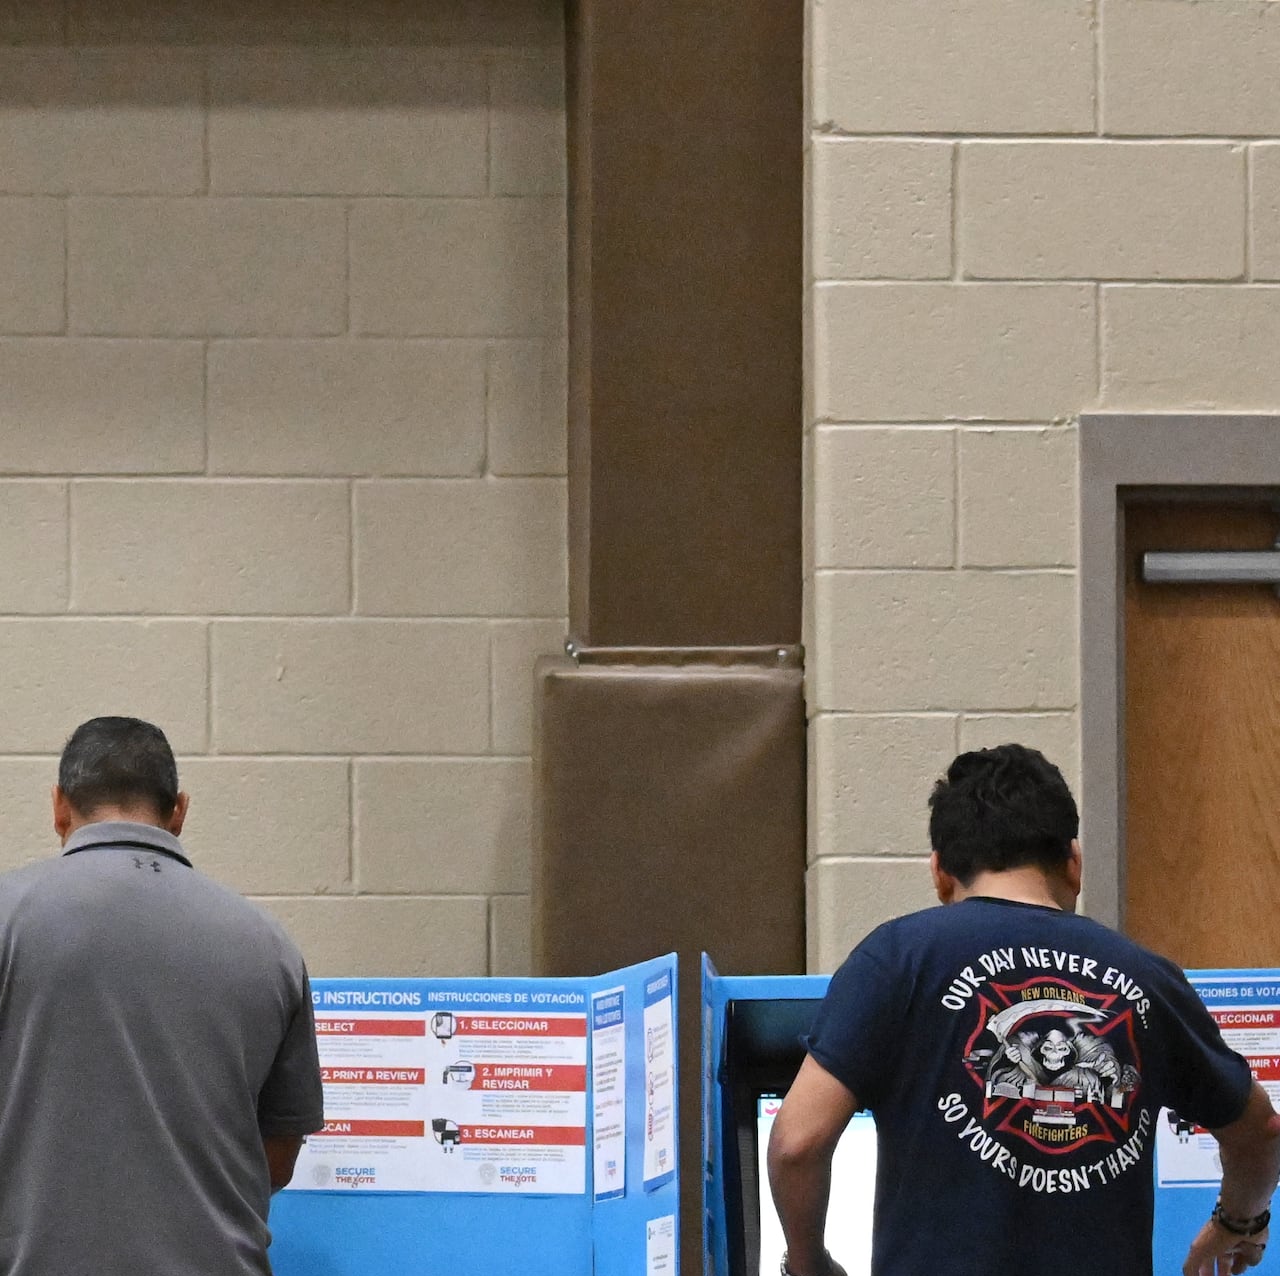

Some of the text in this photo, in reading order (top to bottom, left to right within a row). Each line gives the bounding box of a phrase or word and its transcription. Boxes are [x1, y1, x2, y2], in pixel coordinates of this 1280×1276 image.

[941, 946, 1150, 1030] OUR DAY NEVER ENDS...
[1241, 987, 1253, 997] DE
[323, 991, 421, 1005] INSTRUCTIONS
[428, 991, 584, 1004] INSTRUCCIONES DE VOTACIÓN
[1021, 987, 1086, 1005] NEW ORLEANS
[1214, 1014, 1274, 1024] LECCIONAR
[315, 1022, 355, 1032] SELECT
[460, 1020, 548, 1031] 1. SELECCIONAR
[1247, 1058, 1280, 1068] IMIR Y
[322, 1070, 419, 1081] 2. PRINT & REVIEW
[482, 1068, 553, 1078] 2. IMPRIMIR Y
[483, 1080, 529, 1089] REVISAR
[322, 1123, 351, 1132] SCAN
[1023, 1119, 1088, 1142] FIREFIGHTERS
[463, 1129, 534, 1139] 3. ESCANEAR
[938, 1093, 968, 1123] SO
[958, 1117, 1018, 1180] YOURS
[1018, 1160, 1107, 1194] DOESN'T
[1138, 1108, 1151, 1137] TO
[335, 1167, 375, 1176] SECURE
[499, 1166, 536, 1176] SECURE
